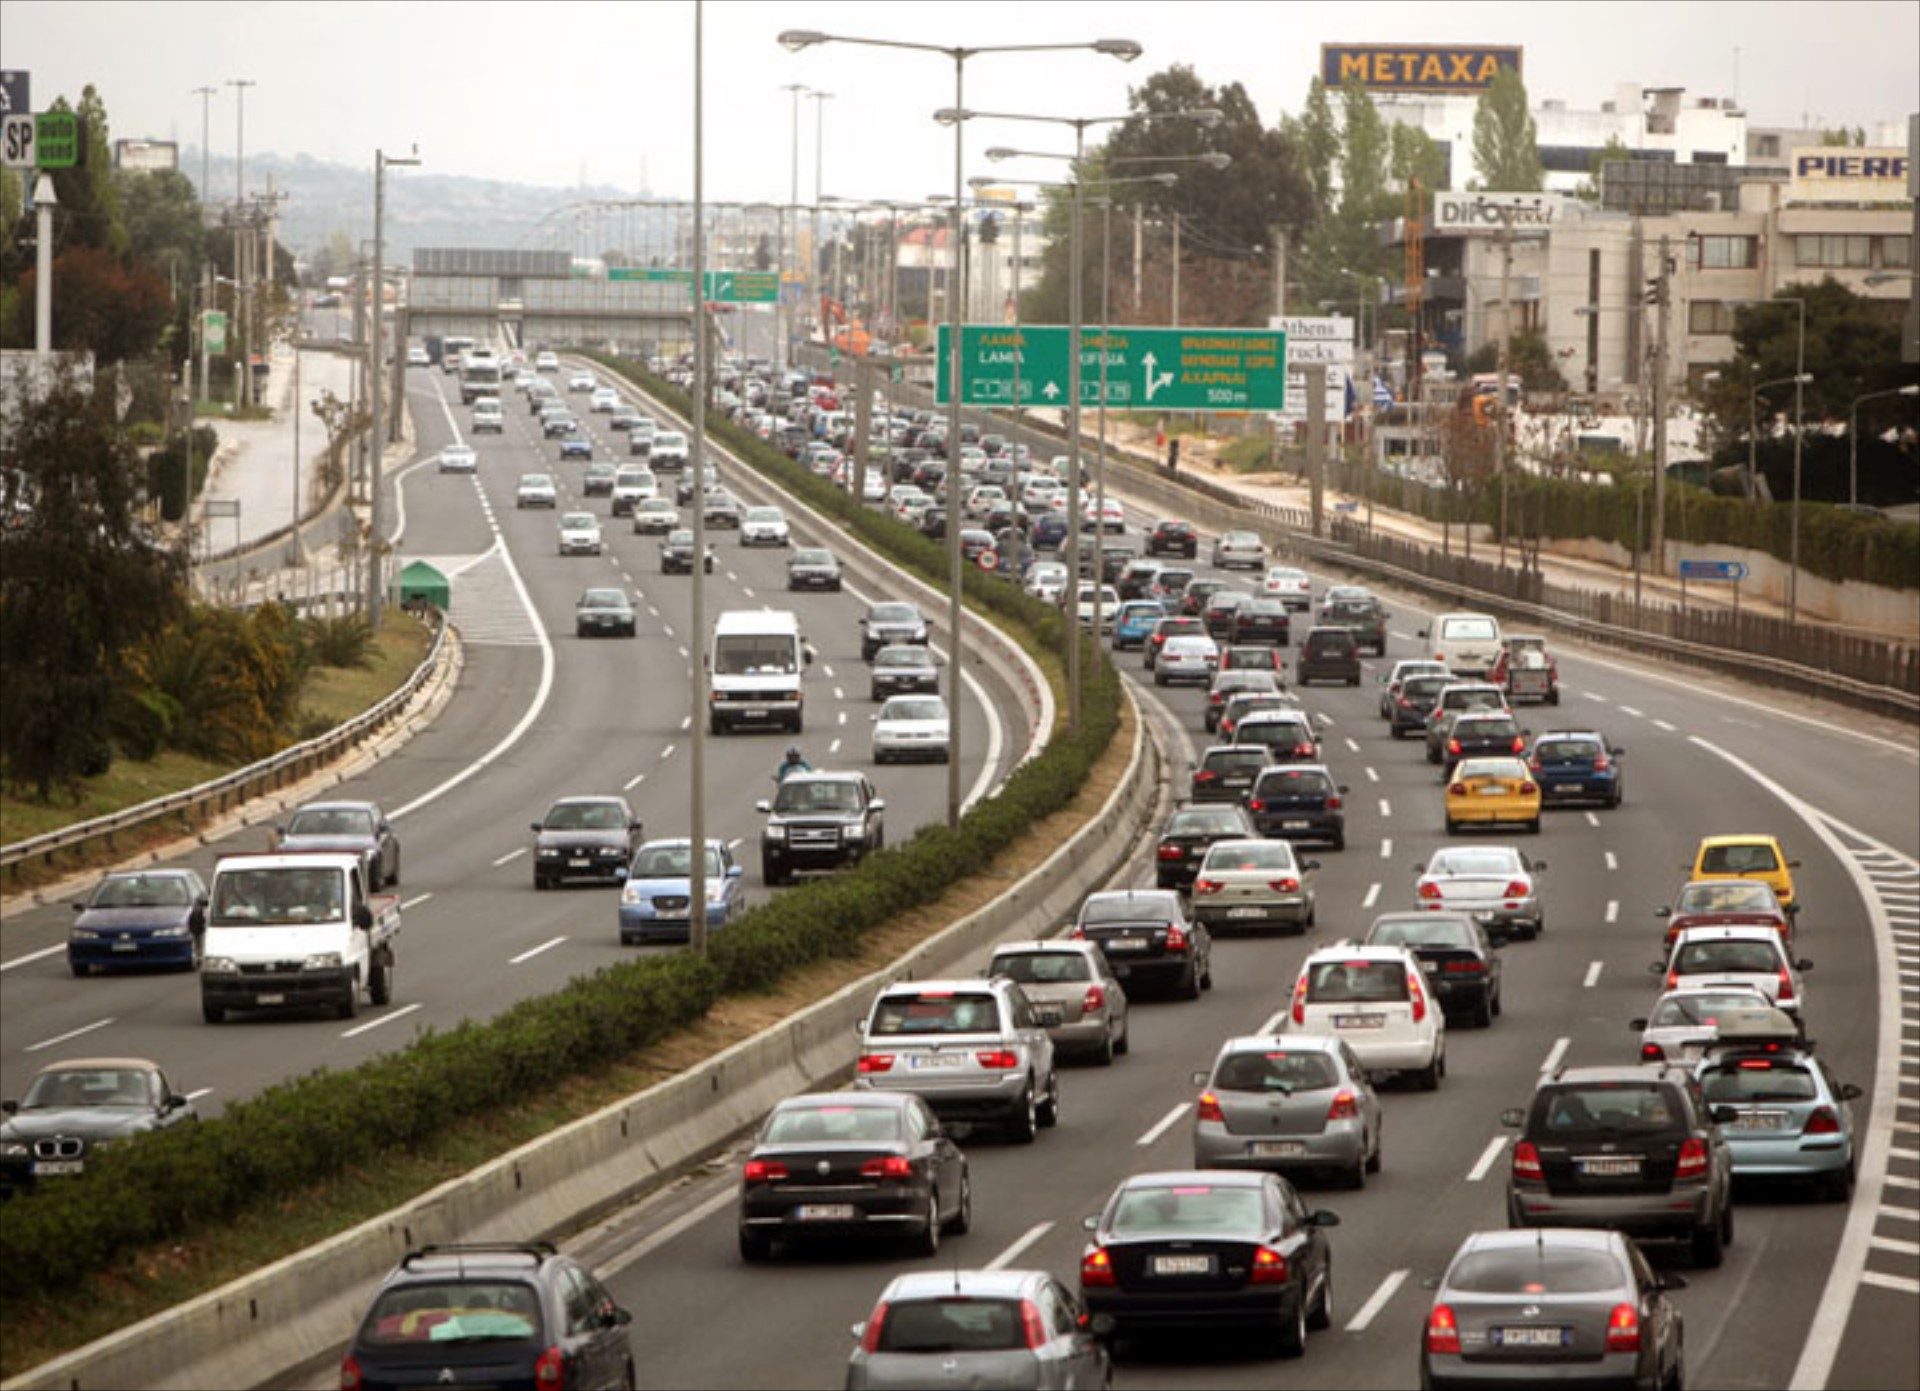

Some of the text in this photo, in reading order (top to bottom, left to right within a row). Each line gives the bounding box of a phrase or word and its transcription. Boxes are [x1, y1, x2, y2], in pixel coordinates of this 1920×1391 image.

[1340, 52, 1499, 81] METAXA
[8, 122, 33, 159] SP
[1289, 344, 1334, 358] rucks
